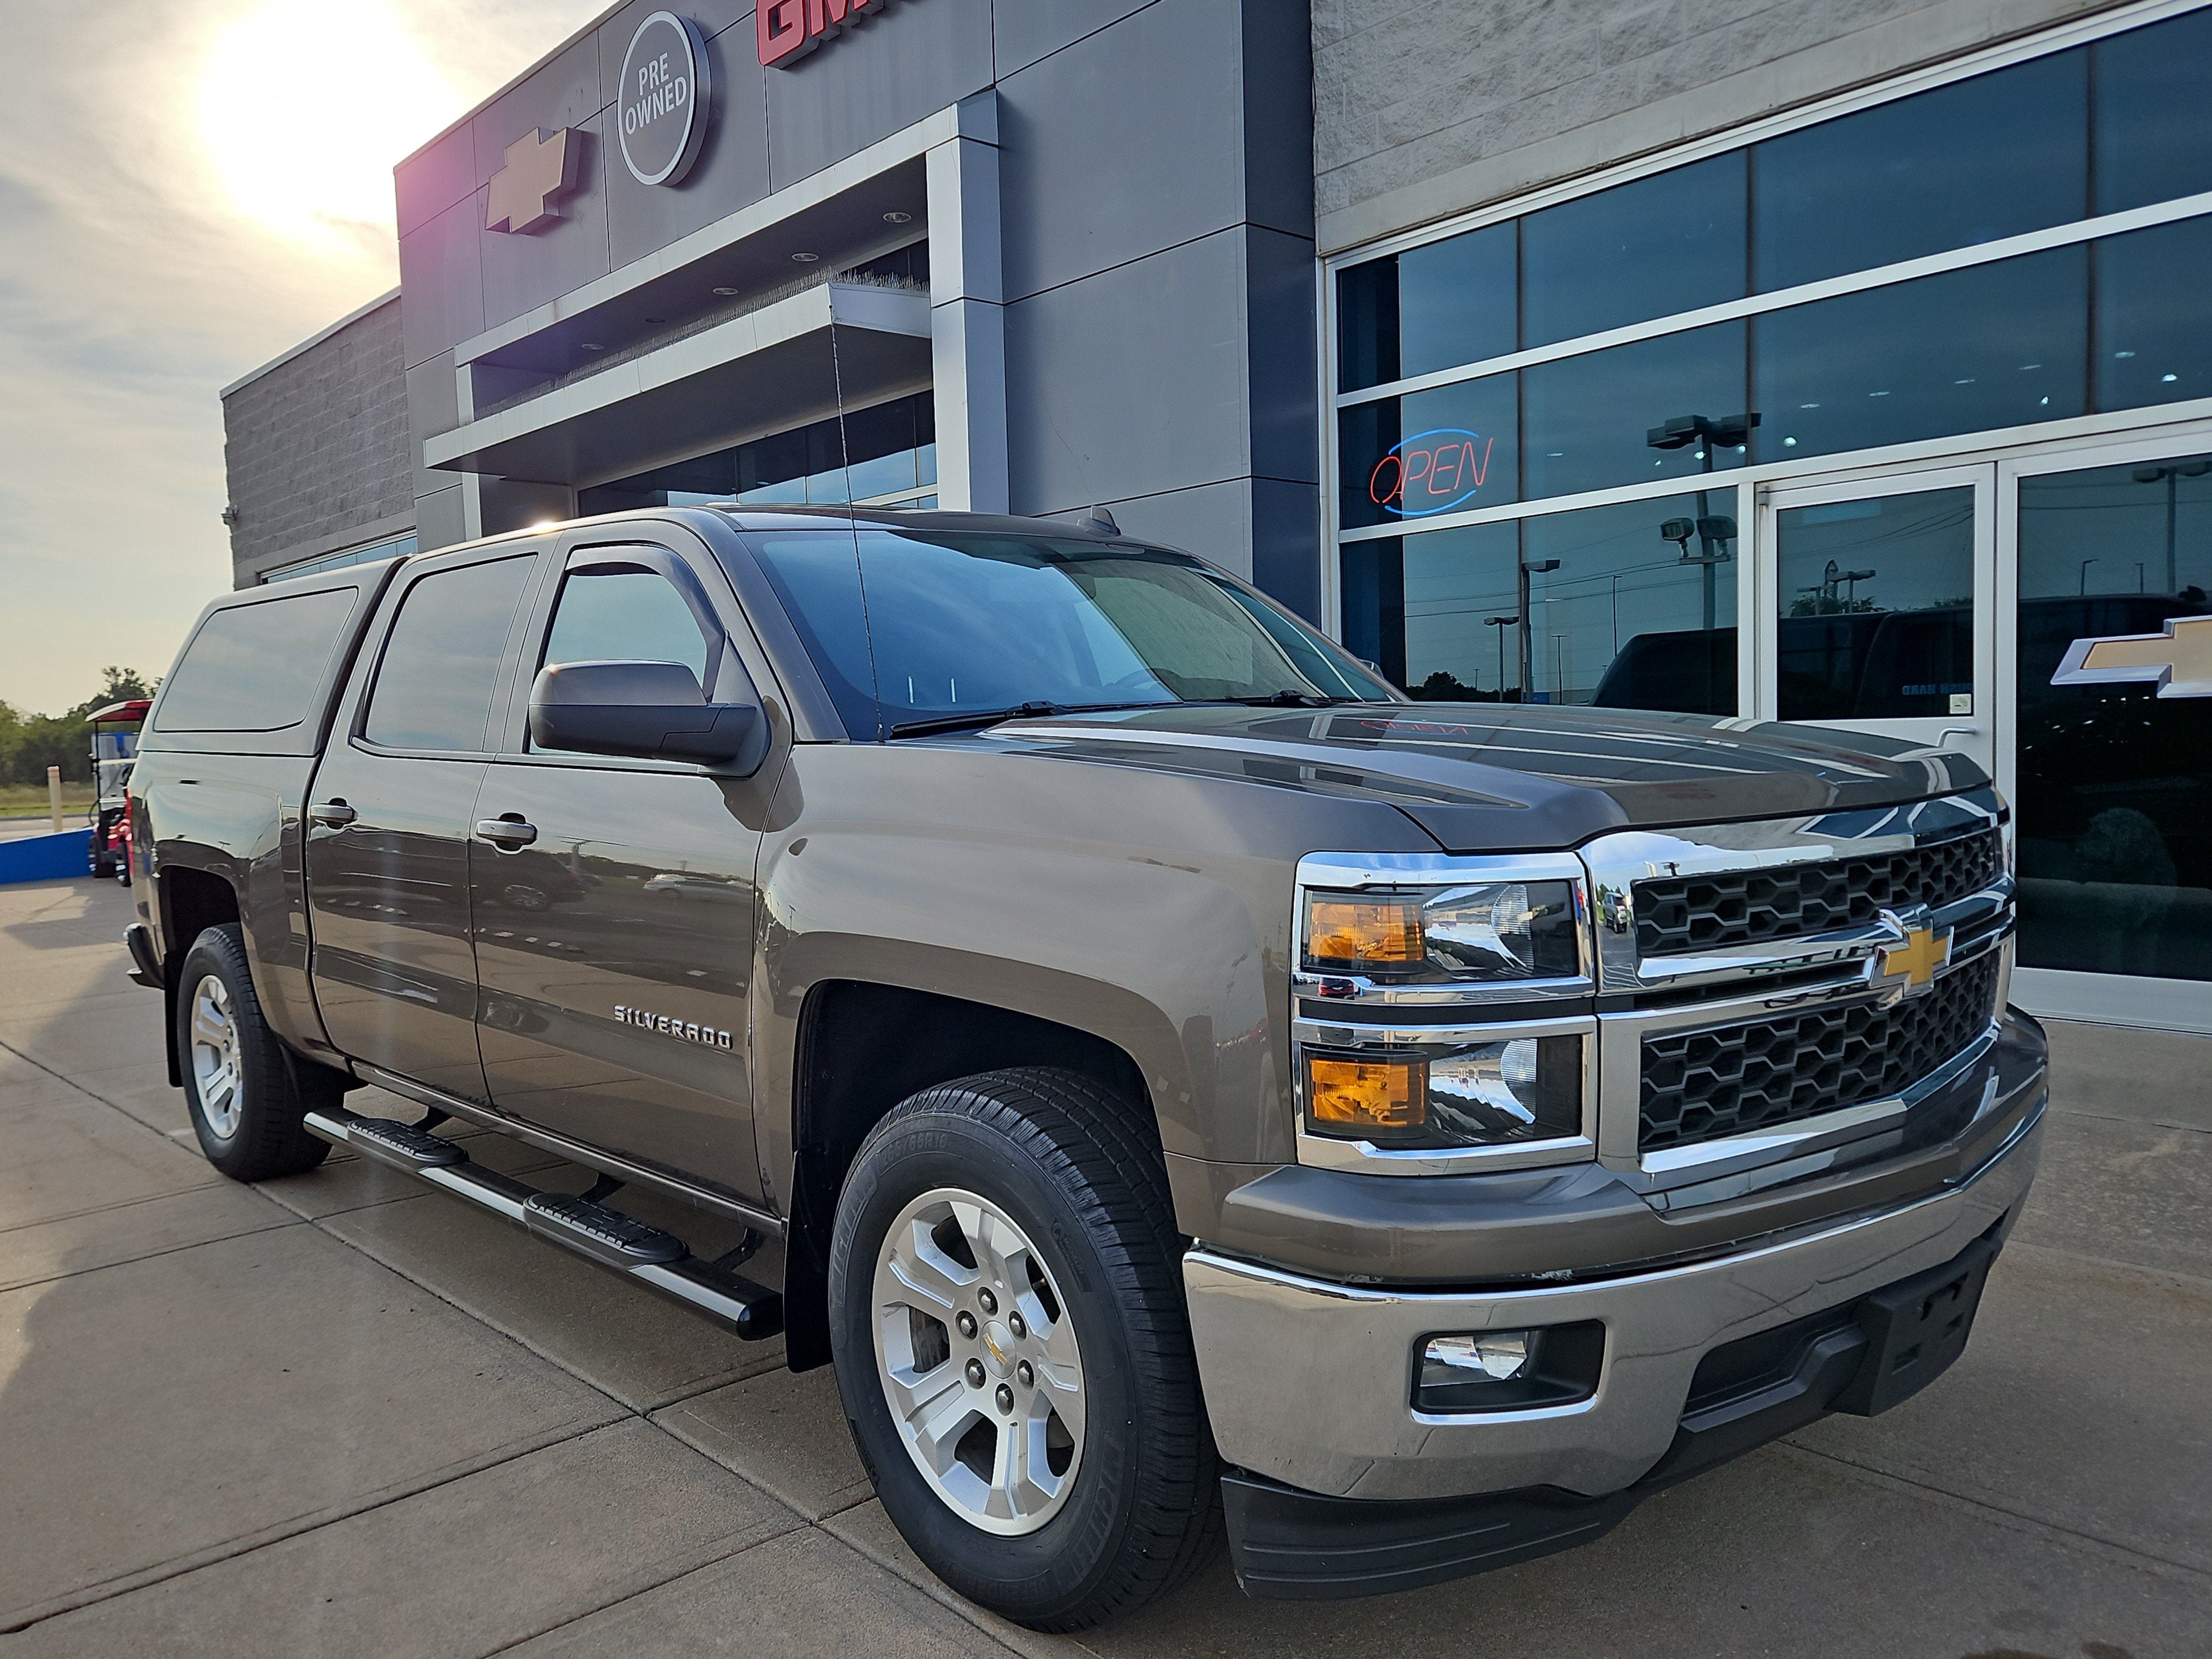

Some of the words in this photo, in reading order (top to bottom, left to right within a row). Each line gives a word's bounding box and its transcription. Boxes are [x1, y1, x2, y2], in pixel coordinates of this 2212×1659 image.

[638, 52, 670, 96] PRE
[625, 76, 687, 135] OWNED
[1370, 437, 1494, 503] OPEN
[614, 1005, 732, 1050] SILVERADO
